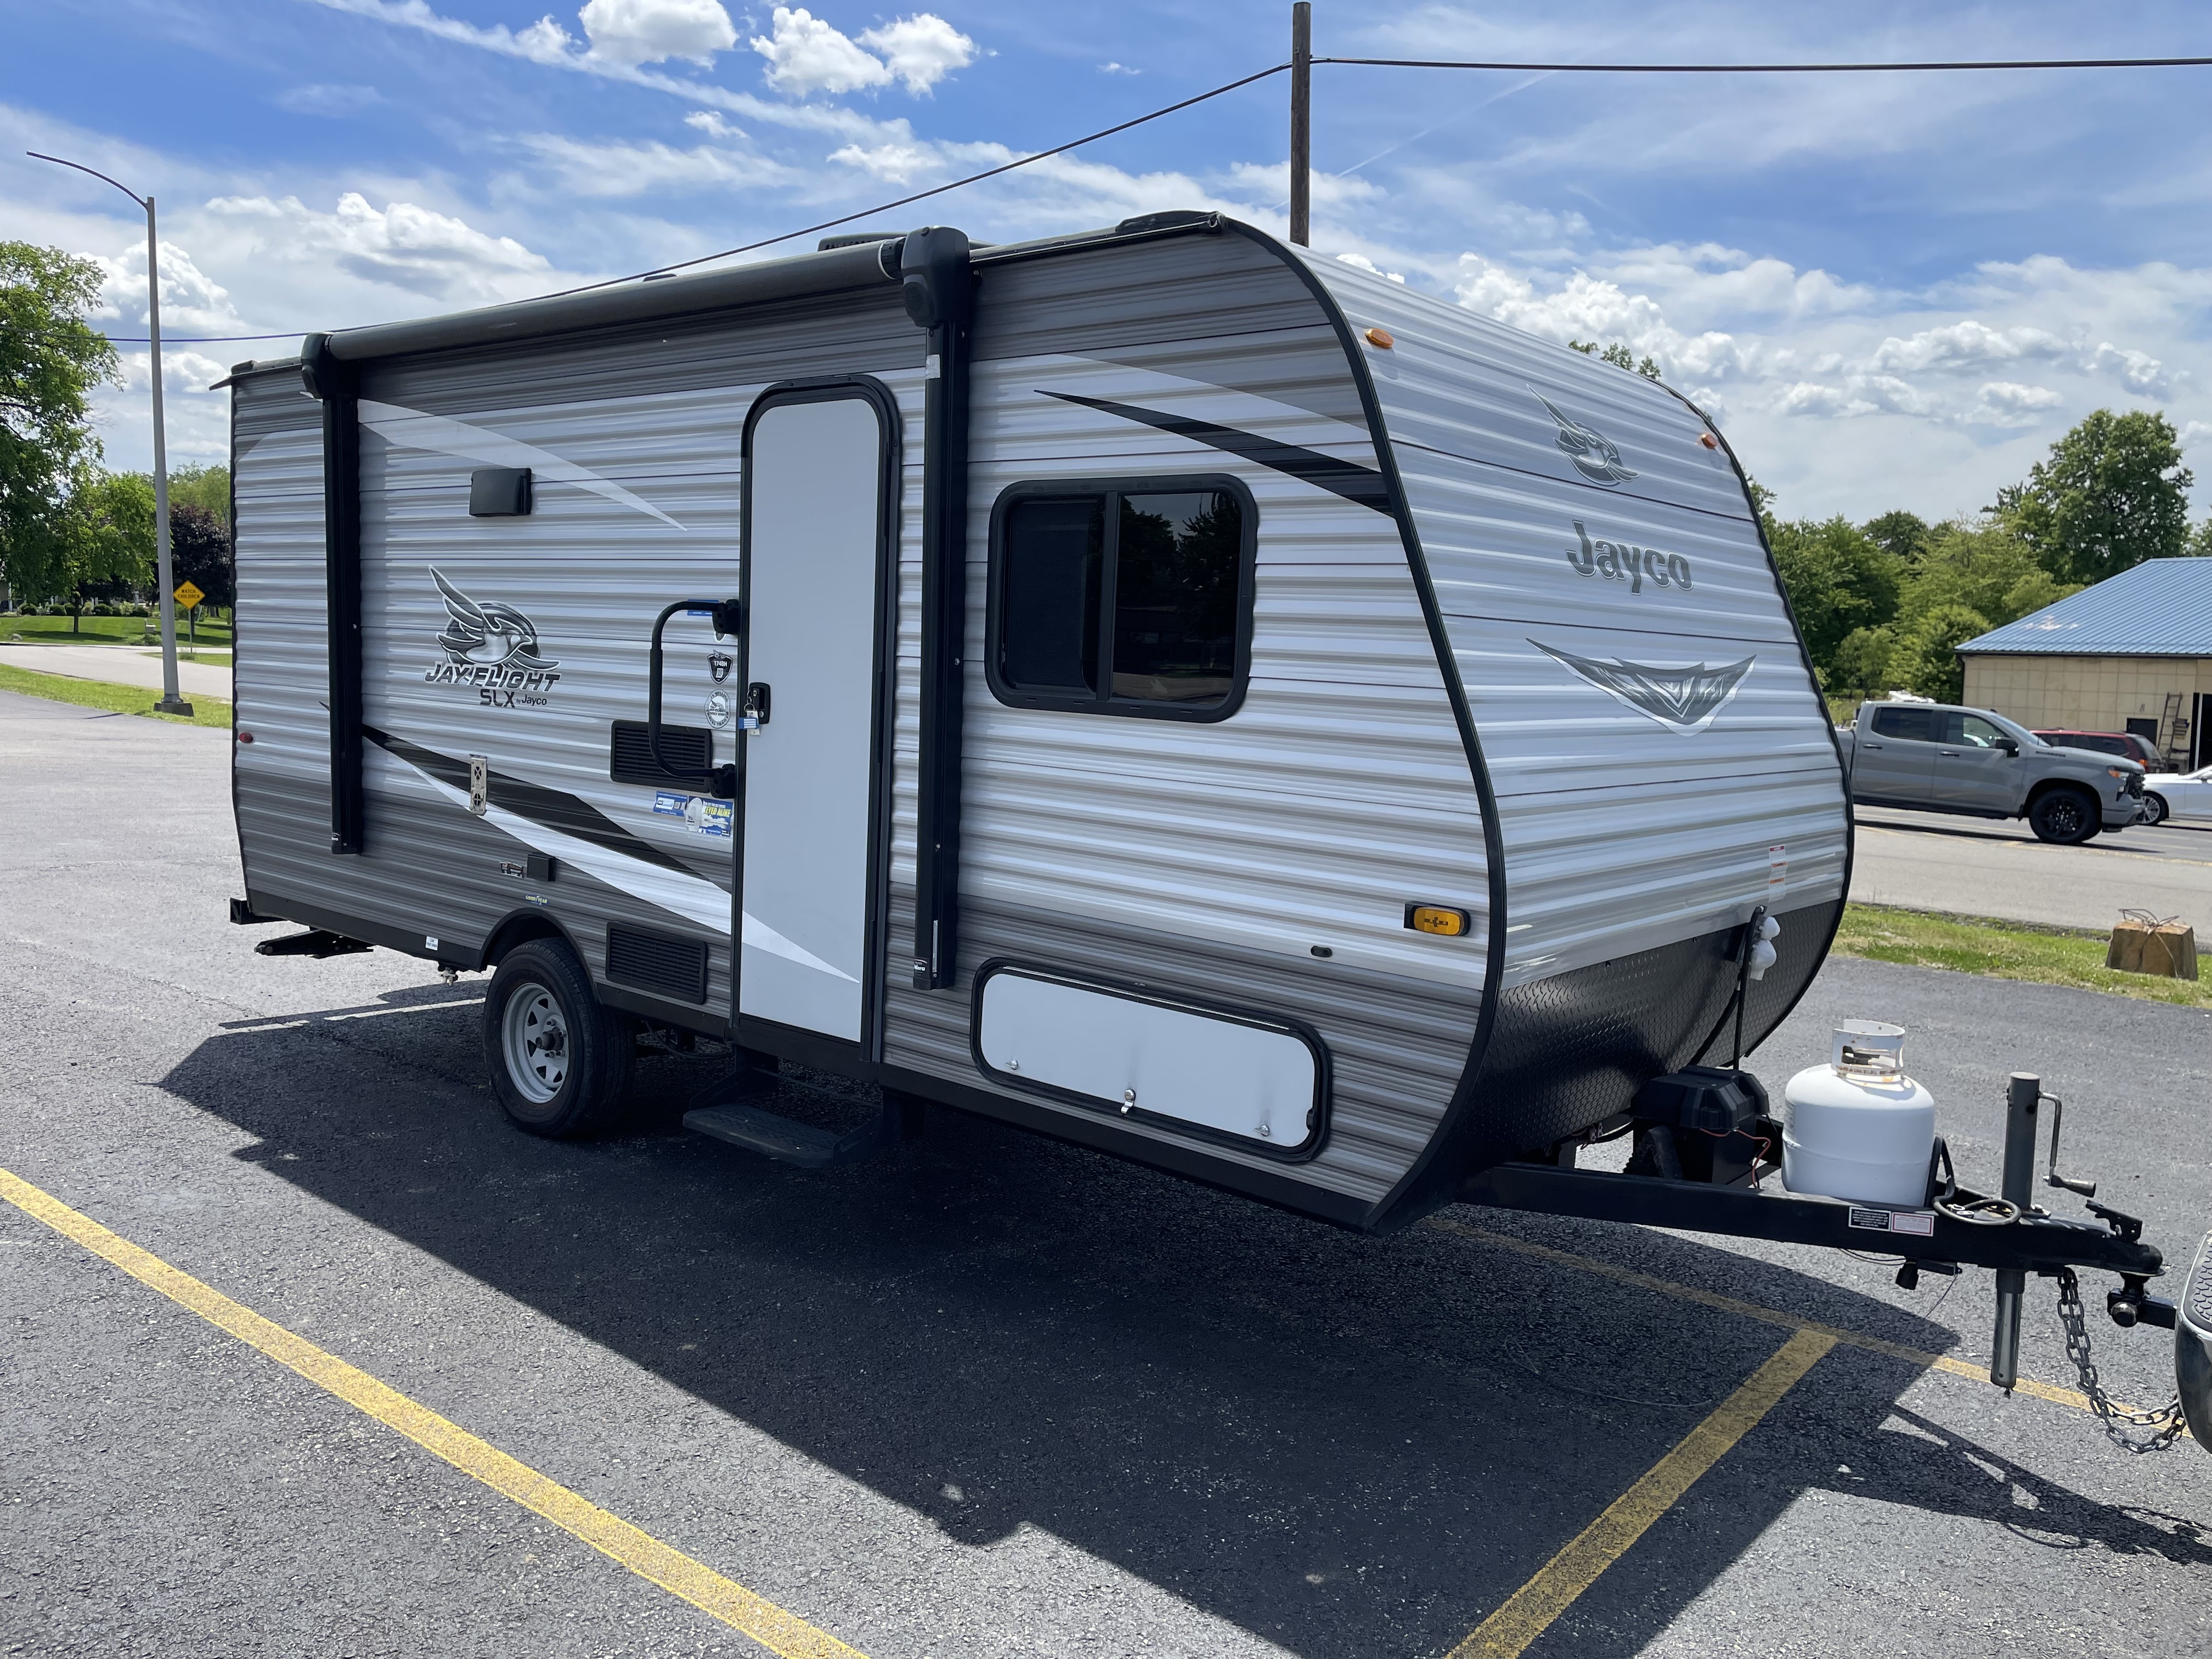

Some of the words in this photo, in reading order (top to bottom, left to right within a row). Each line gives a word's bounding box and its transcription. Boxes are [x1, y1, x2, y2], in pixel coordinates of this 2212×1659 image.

[1565, 520, 1694, 596] Jayco
[424, 662, 471, 684] JAY
[469, 664, 562, 692] FLIGHT
[480, 689, 515, 708] SLX
[522, 695, 547, 706] Jayco
[705, 806, 717, 815] EYED
